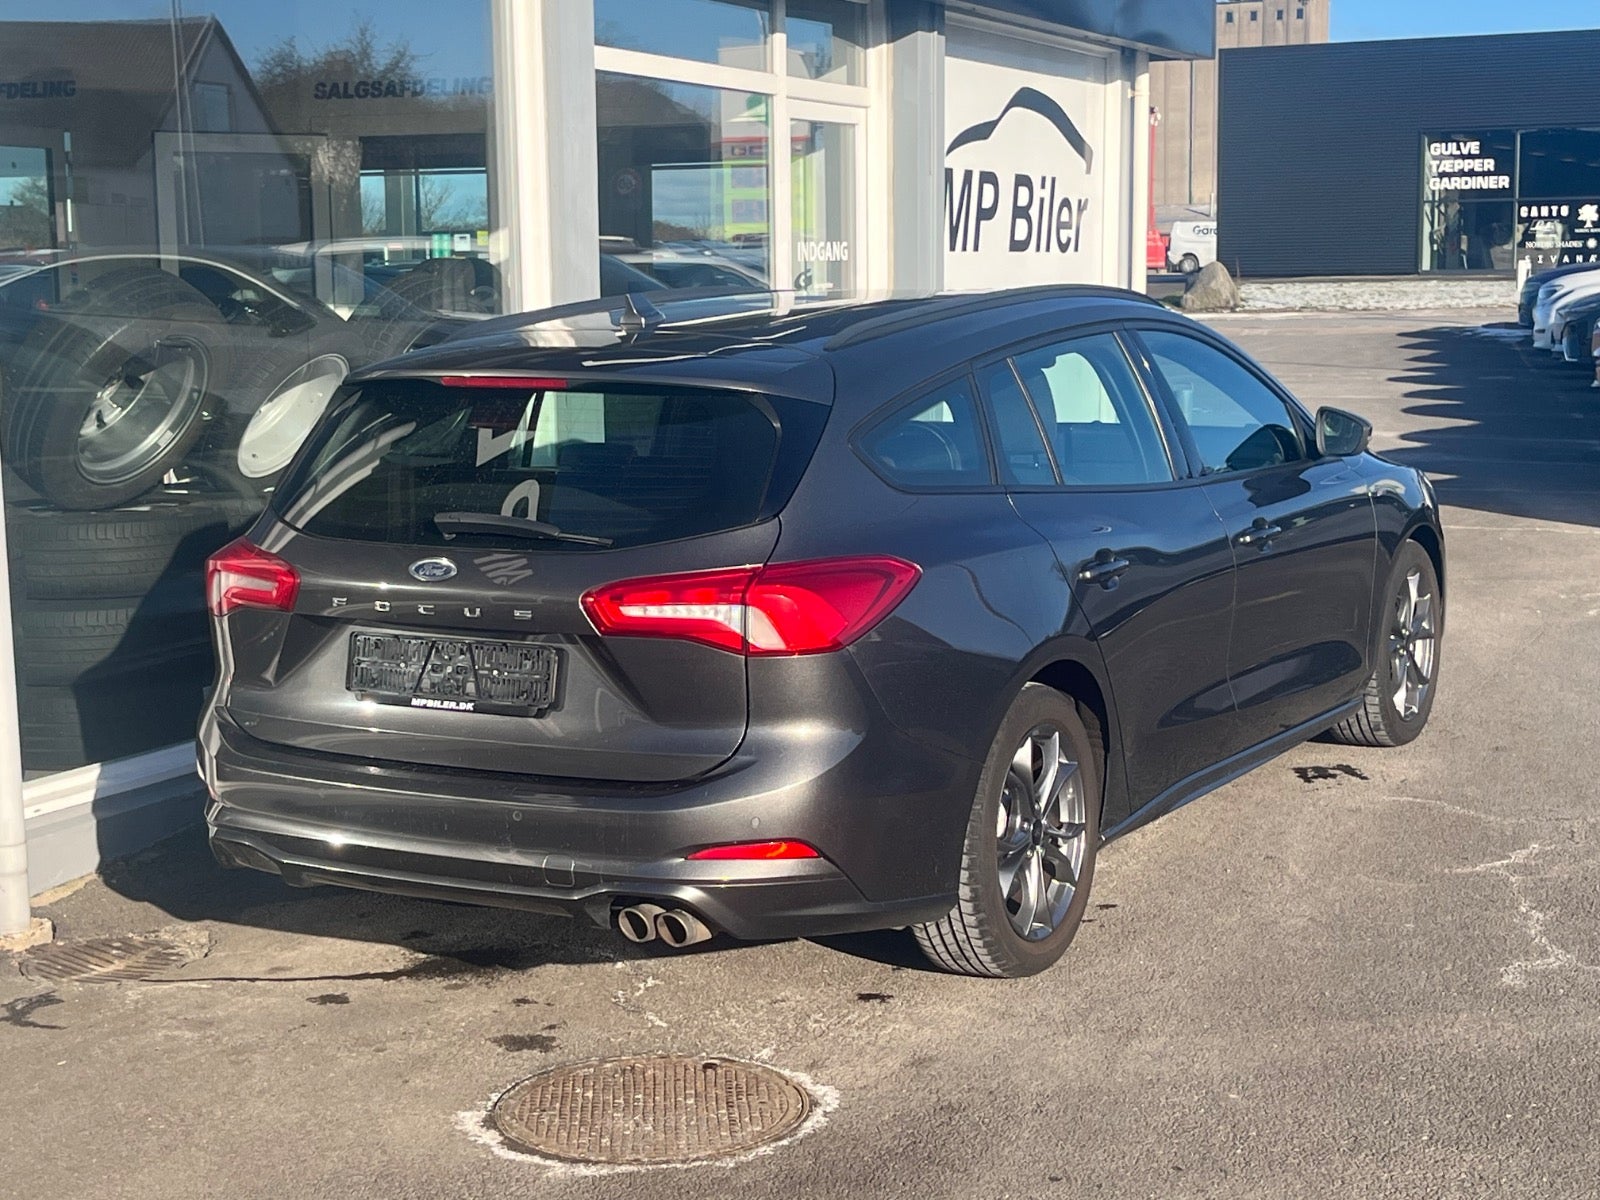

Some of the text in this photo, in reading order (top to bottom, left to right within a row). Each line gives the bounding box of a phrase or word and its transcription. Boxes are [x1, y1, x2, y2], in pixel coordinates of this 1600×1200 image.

[313, 76, 493, 100] SALGSAFDELING
[1430, 141, 1480, 156] GULVE
[1430, 158, 1495, 173] TÆPPER
[1429, 175, 1510, 190] GARDINER
[944, 168, 1089, 253] MP Biler
[797, 241, 849, 262] INDGANG
[332, 597, 533, 620] FOCUS
[410, 697, 475, 711] MPBILER.DK
